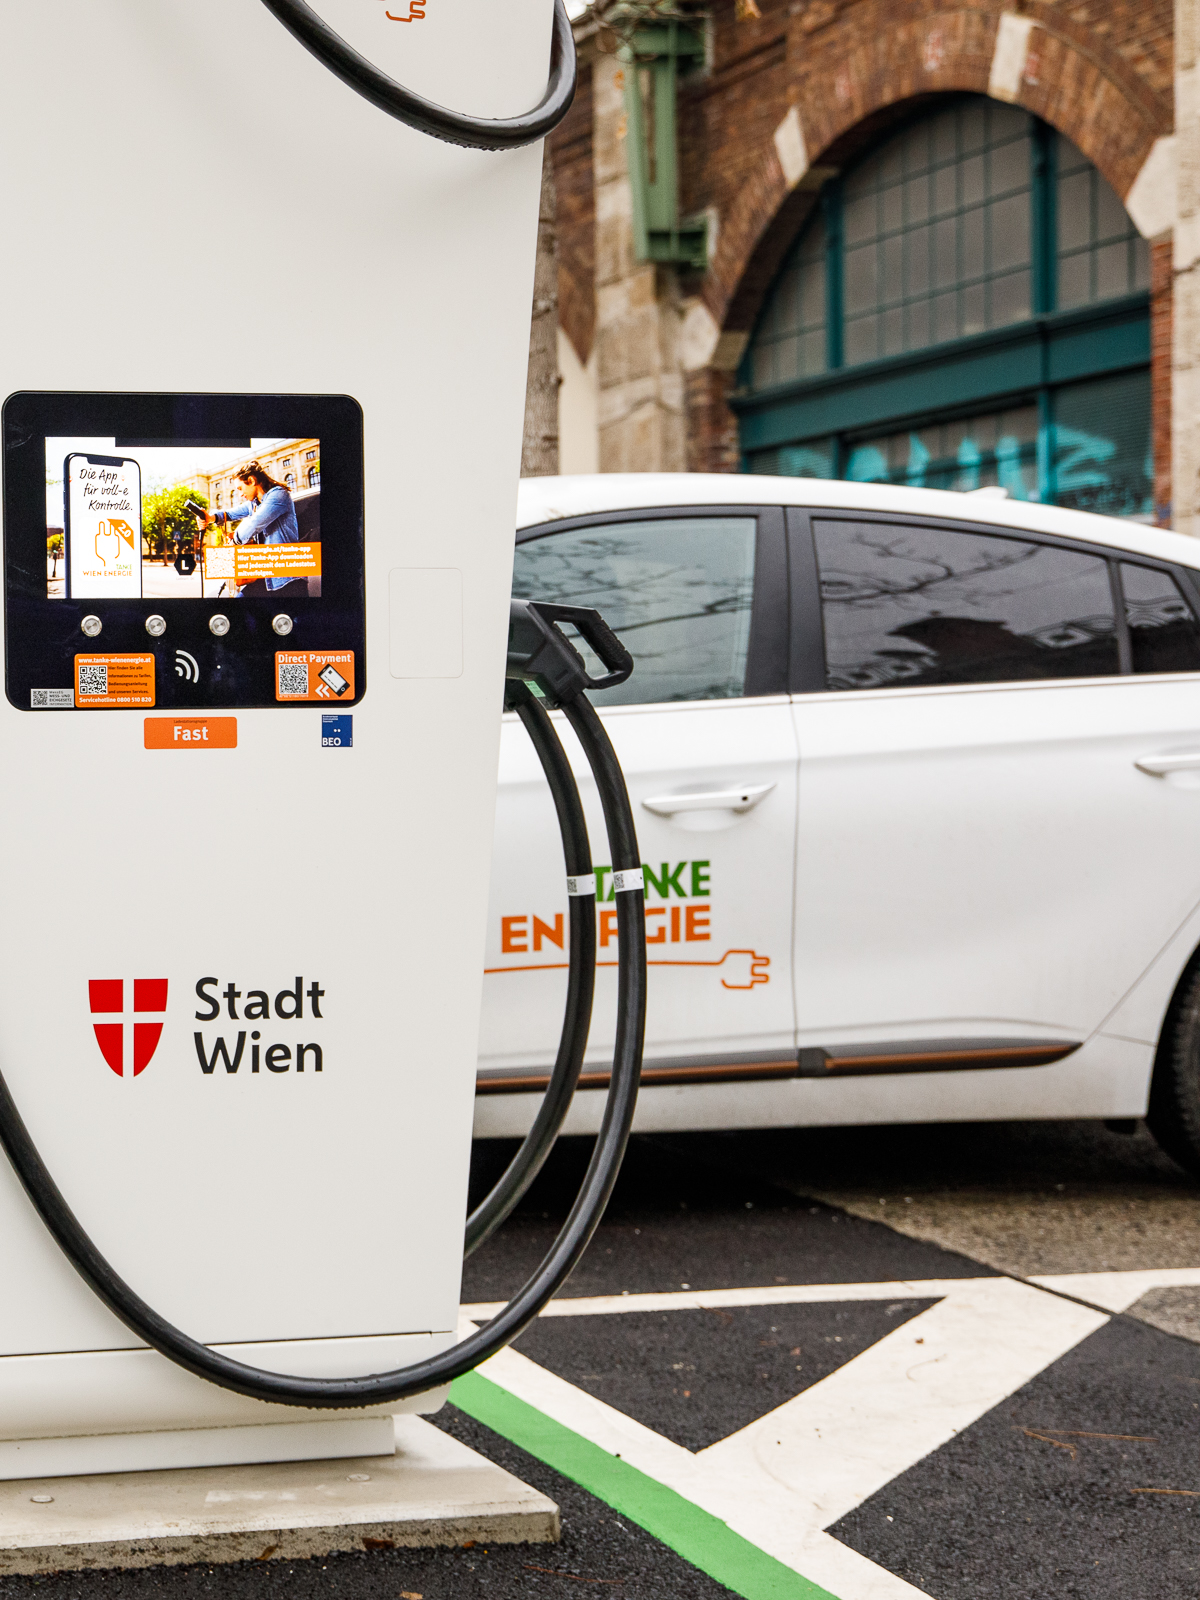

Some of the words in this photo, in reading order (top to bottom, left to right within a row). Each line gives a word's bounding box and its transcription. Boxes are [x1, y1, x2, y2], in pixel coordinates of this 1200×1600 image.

[79, 468, 97, 480] Die
[98, 469, 118, 484] App
[83, 482, 99, 497] für
[101, 484, 129, 496] voll-e
[88, 499, 133, 511] Kontrolle.
[249, 562, 274, 570] jederzeit
[278, 654, 307, 663] Direct
[309, 653, 351, 665] Payment
[173, 725, 209, 741] Fast
[593, 860, 710, 902] TNKE
[501, 904, 711, 954] ENRGIE
[195, 976, 325, 1022] Stadt
[193, 1030, 323, 1074] Wien
